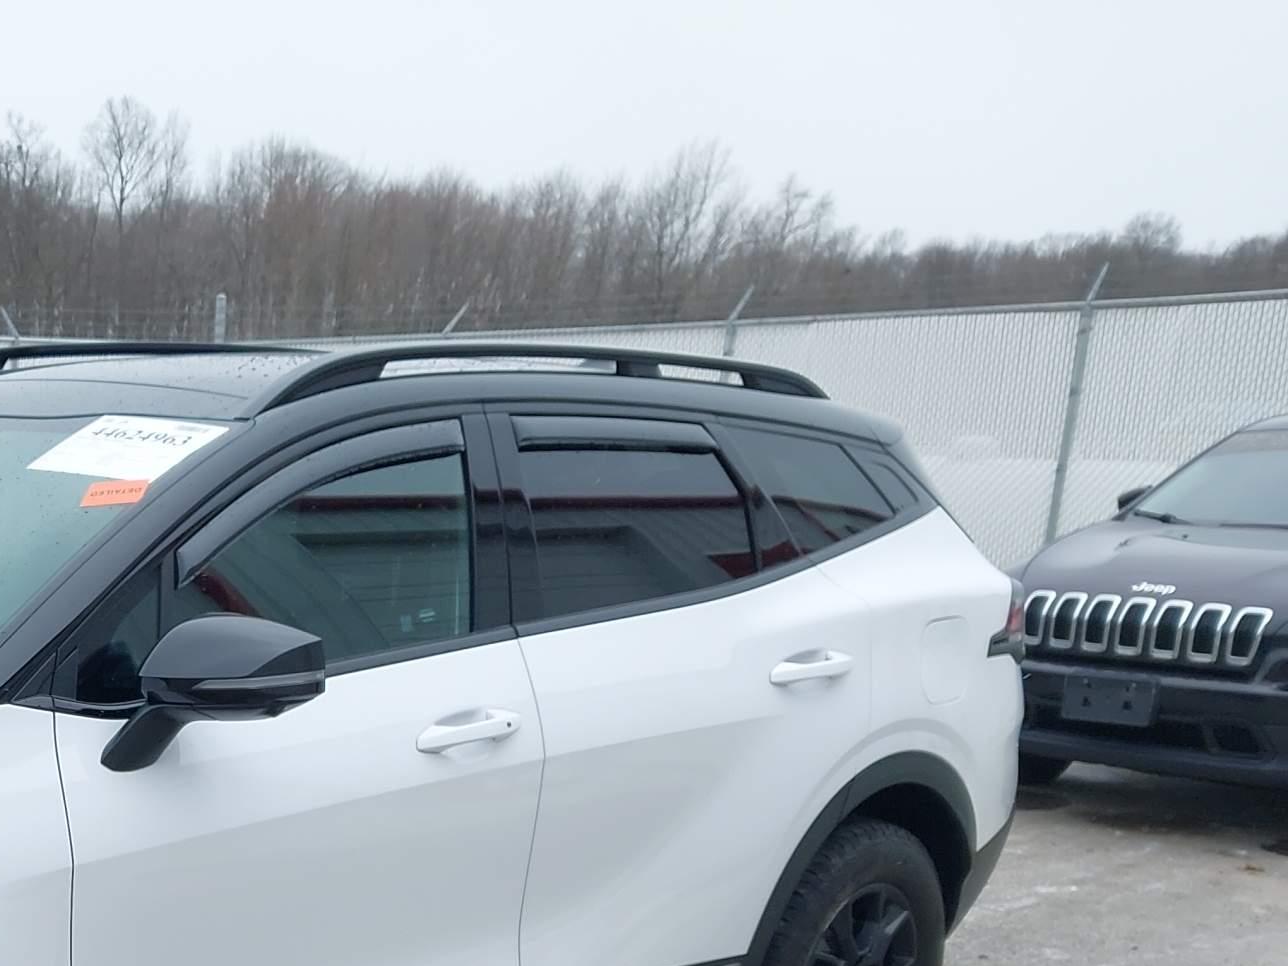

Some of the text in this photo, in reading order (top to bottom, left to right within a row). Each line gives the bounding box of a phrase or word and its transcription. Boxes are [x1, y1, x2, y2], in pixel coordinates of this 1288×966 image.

[91, 427, 193, 447] 44624963
[89, 486, 143, 497] DETAILED
[1131, 581, 1177, 596] Jeep
